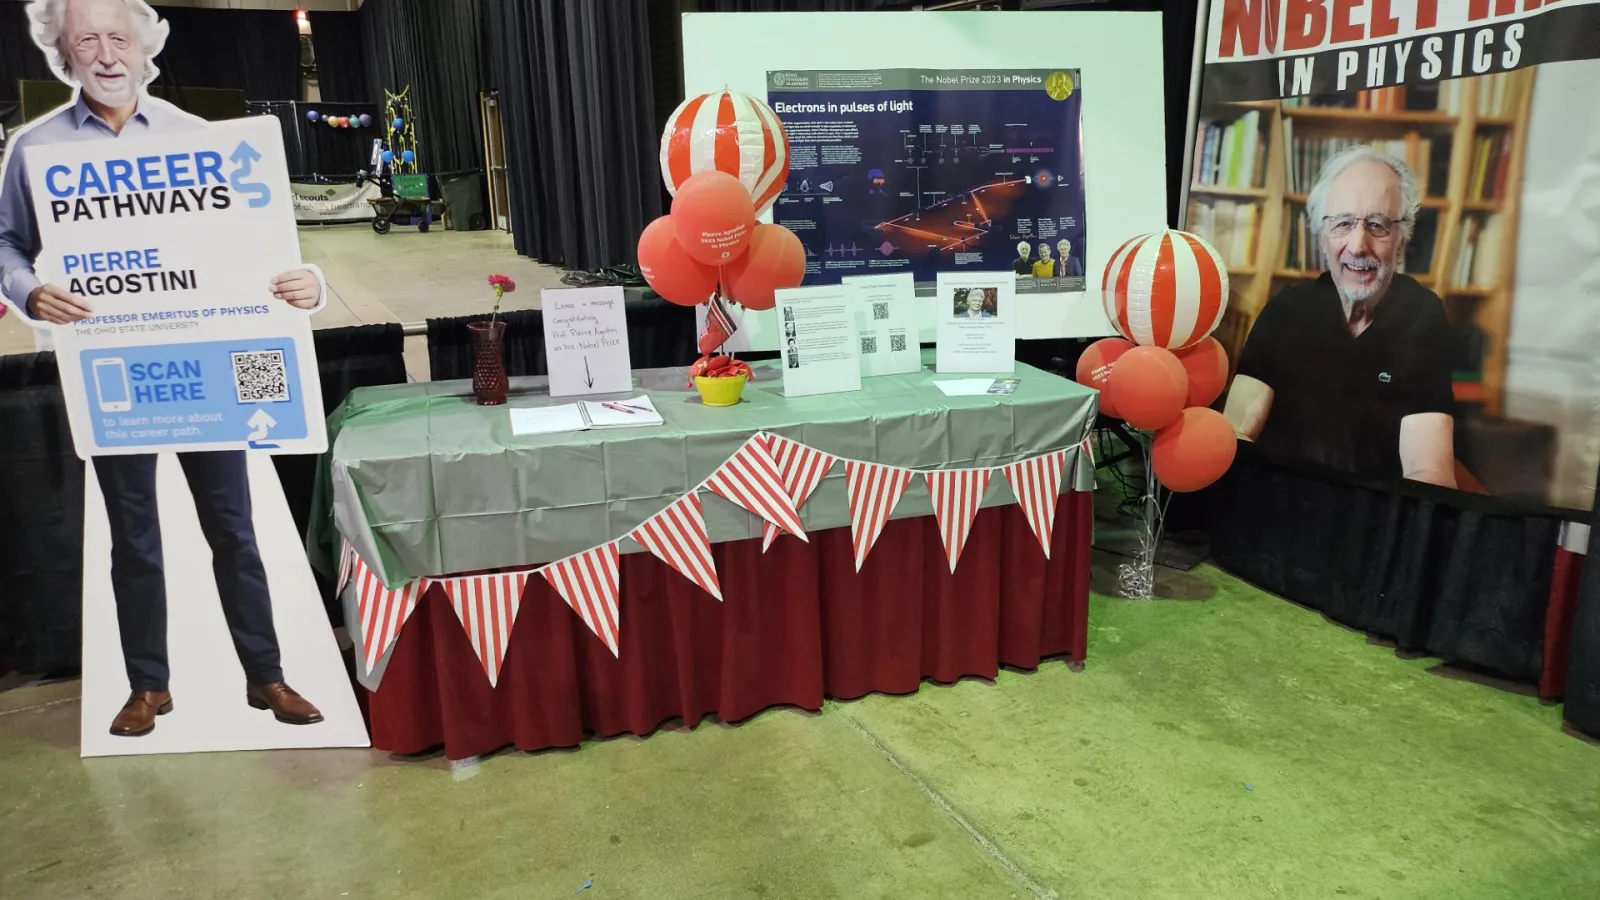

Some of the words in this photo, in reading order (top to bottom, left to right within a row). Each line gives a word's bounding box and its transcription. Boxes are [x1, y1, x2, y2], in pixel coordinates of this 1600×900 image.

[1278, 56, 1315, 97] IN
[1336, 22, 1525, 91] PHYSICS
[921, 75, 933, 84] The
[936, 76, 959, 84] Nobel
[960, 75, 979, 84] Prize
[982, 75, 1002, 84] 2023
[1003, 75, 1012, 84] in
[1012, 75, 1042, 84] Physics
[775, 102, 826, 113] Electrons
[828, 102, 838, 112] in
[840, 101, 876, 115] pulses
[877, 100, 888, 111] of
[889, 100, 914, 113] light
[45, 150, 228, 198] CAREER
[50, 185, 231, 223] PATHWAYS
[717, 234, 734, 243] Nobel
[63, 248, 162, 274] PIERRE
[69, 269, 197, 297] AGOSTINI
[555, 301, 575, 310] Leave
[591, 299, 614, 309] message
[142, 309, 199, 321] EMERITUS
[202, 308, 217, 317] OF
[220, 305, 269, 316] PHYSICS
[75, 328, 93, 336] THE
[94, 326, 117, 335] OHIO
[119, 324, 147, 334] STATE
[149, 321, 199, 332] UNIVERSITY
[569, 328, 593, 337] Pierre
[553, 344, 562, 352] on
[578, 340, 600, 350] Nobel
[601, 338, 621, 348] Prize
[130, 360, 201, 382] SCAN
[134, 382, 205, 403] HERE
[102, 418, 116, 427] to
[119, 416, 150, 426] learn
[153, 414, 184, 424] more
[188, 412, 223, 423] about
[105, 430, 128, 440] this
[131, 428, 168, 438] career
[172, 426, 204, 438] path.
